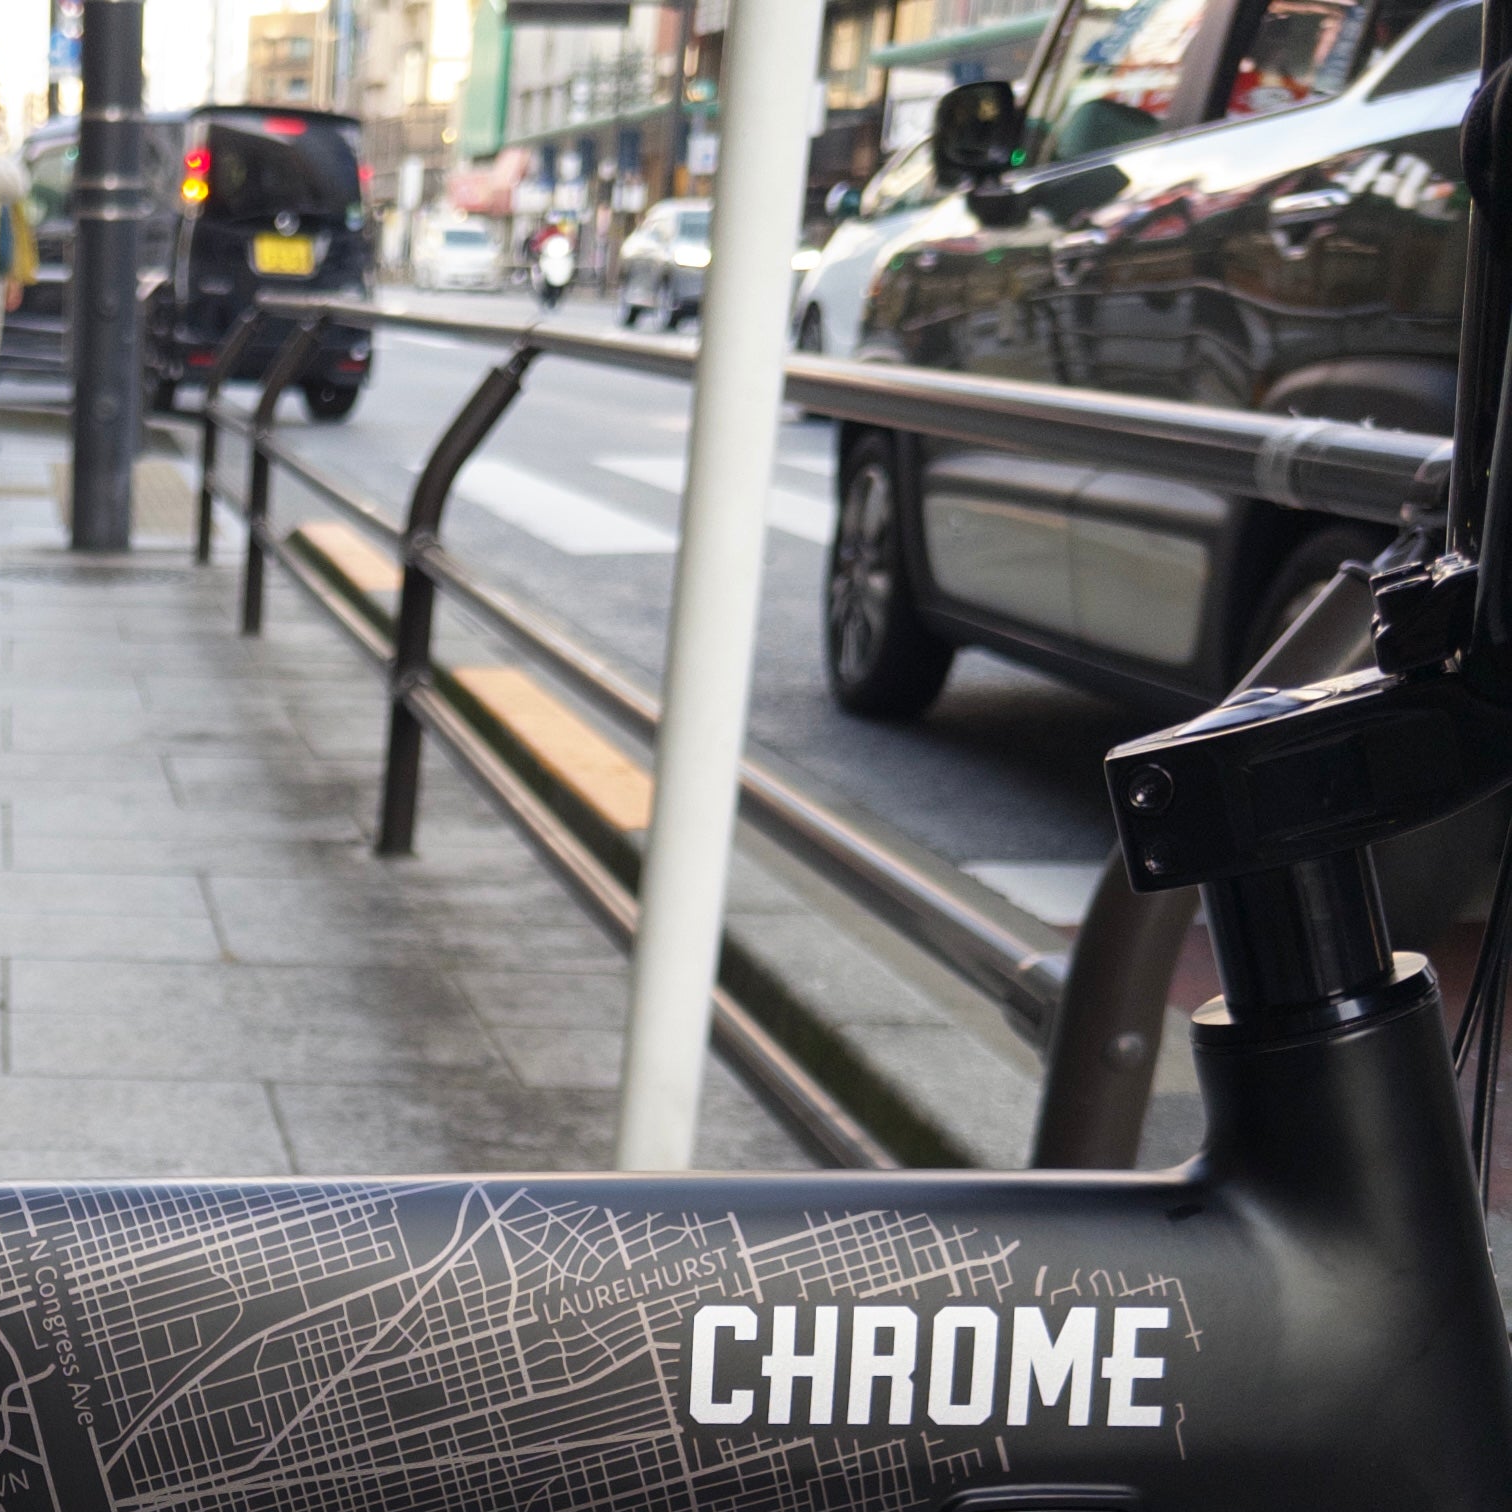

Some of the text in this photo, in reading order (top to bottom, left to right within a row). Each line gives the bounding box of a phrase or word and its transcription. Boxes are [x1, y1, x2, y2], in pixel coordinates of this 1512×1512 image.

[27, 1239, 95, 1428] N Congress Ave
[542, 1246, 729, 1325] LAURELHURST
[688, 1304, 1170, 1428] CHROME
